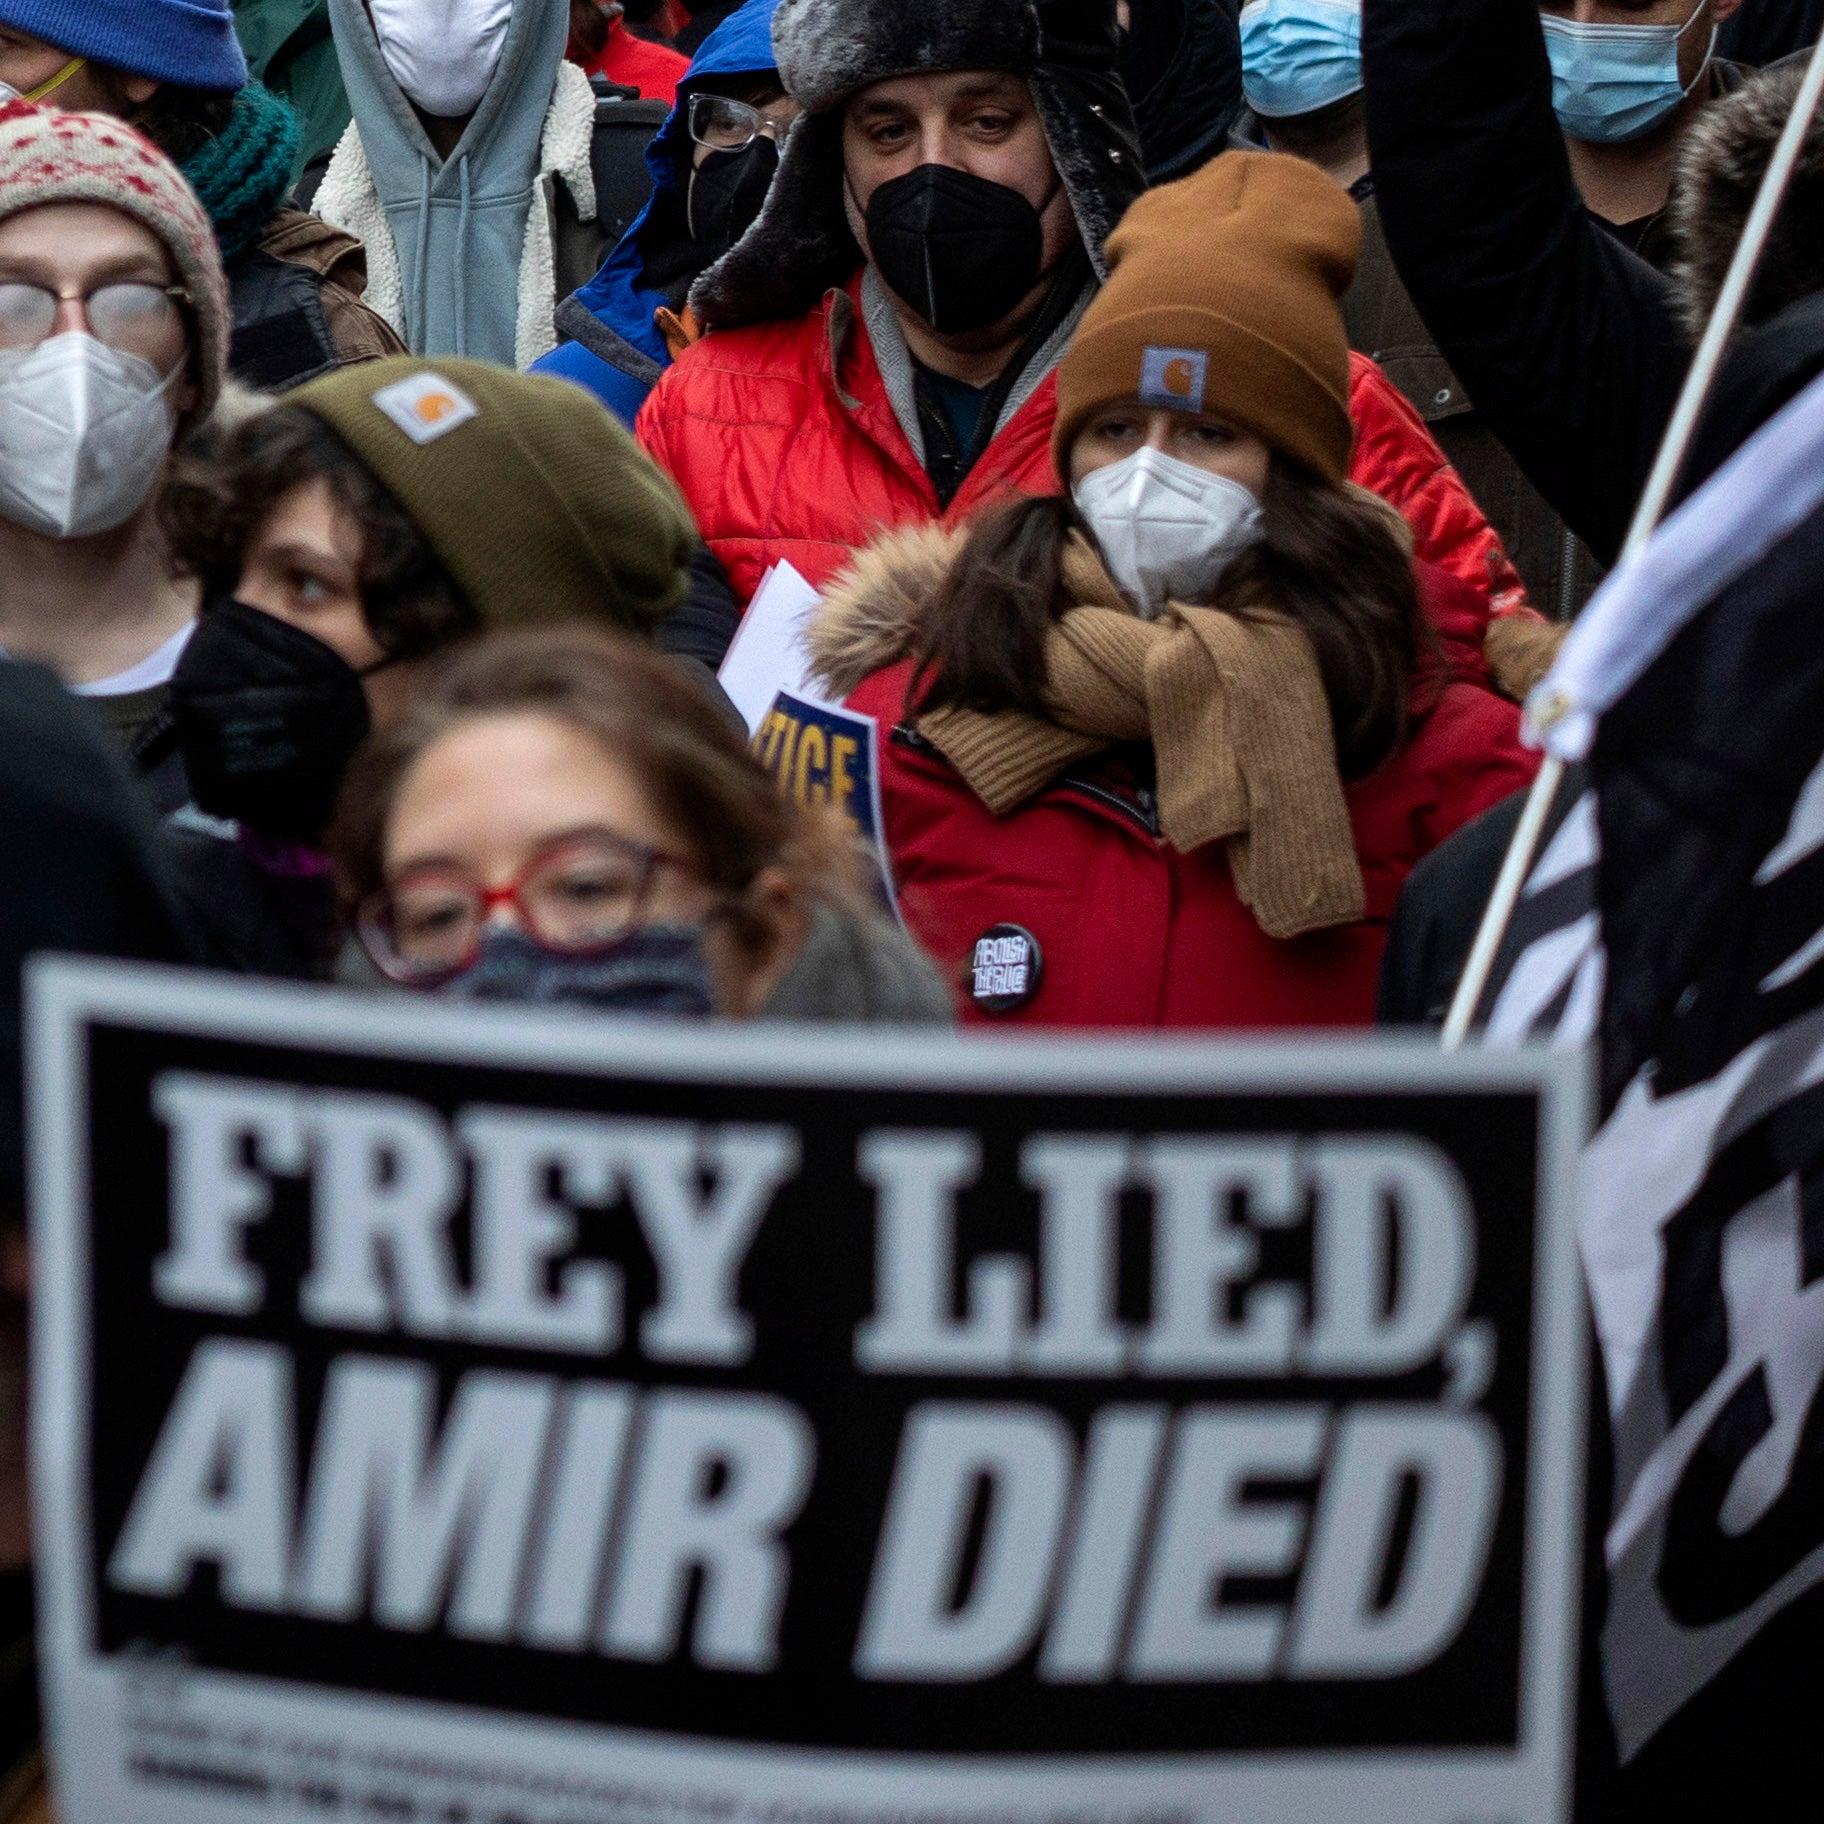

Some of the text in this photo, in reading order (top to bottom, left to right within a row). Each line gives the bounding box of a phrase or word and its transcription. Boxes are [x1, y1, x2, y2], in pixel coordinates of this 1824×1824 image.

[973, 935, 1030, 967] ABOLISH
[152, 1069, 1498, 1408] FREY LIED,
[105, 1332, 1503, 1682] AMIR DIED
